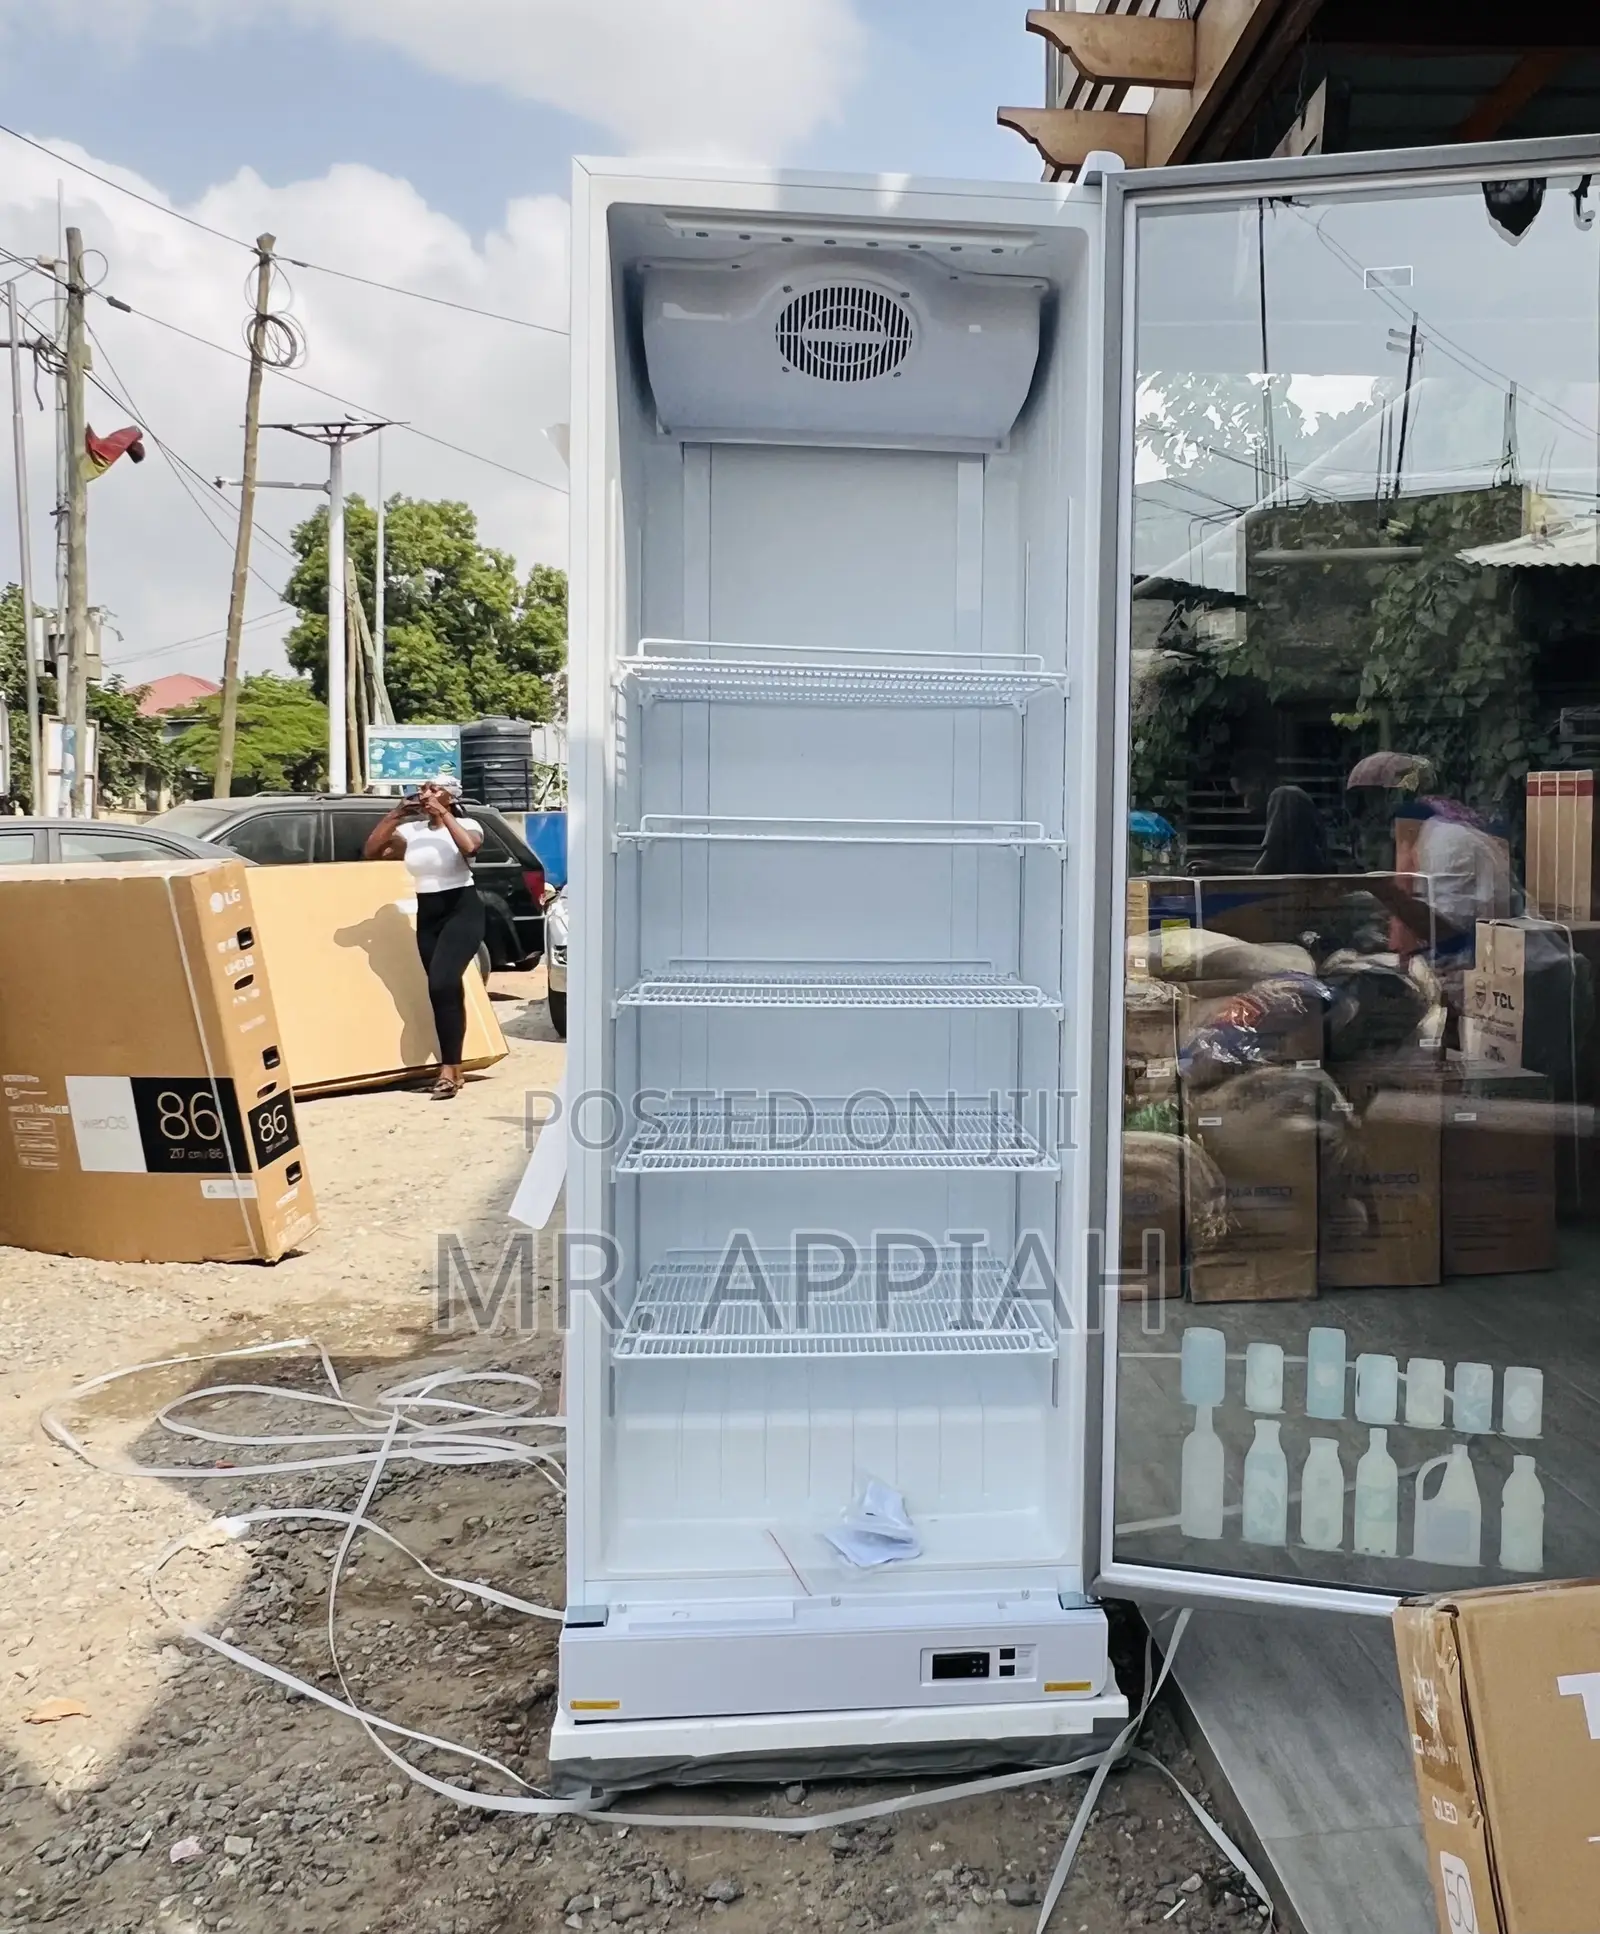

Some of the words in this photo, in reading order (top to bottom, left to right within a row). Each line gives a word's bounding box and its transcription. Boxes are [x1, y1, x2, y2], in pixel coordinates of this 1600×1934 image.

[1492, 991, 1515, 1010] TCL
[157, 1091, 222, 1141] 86
[258, 1104, 288, 1142] 86
[1444, 1867, 1475, 1934] 50
